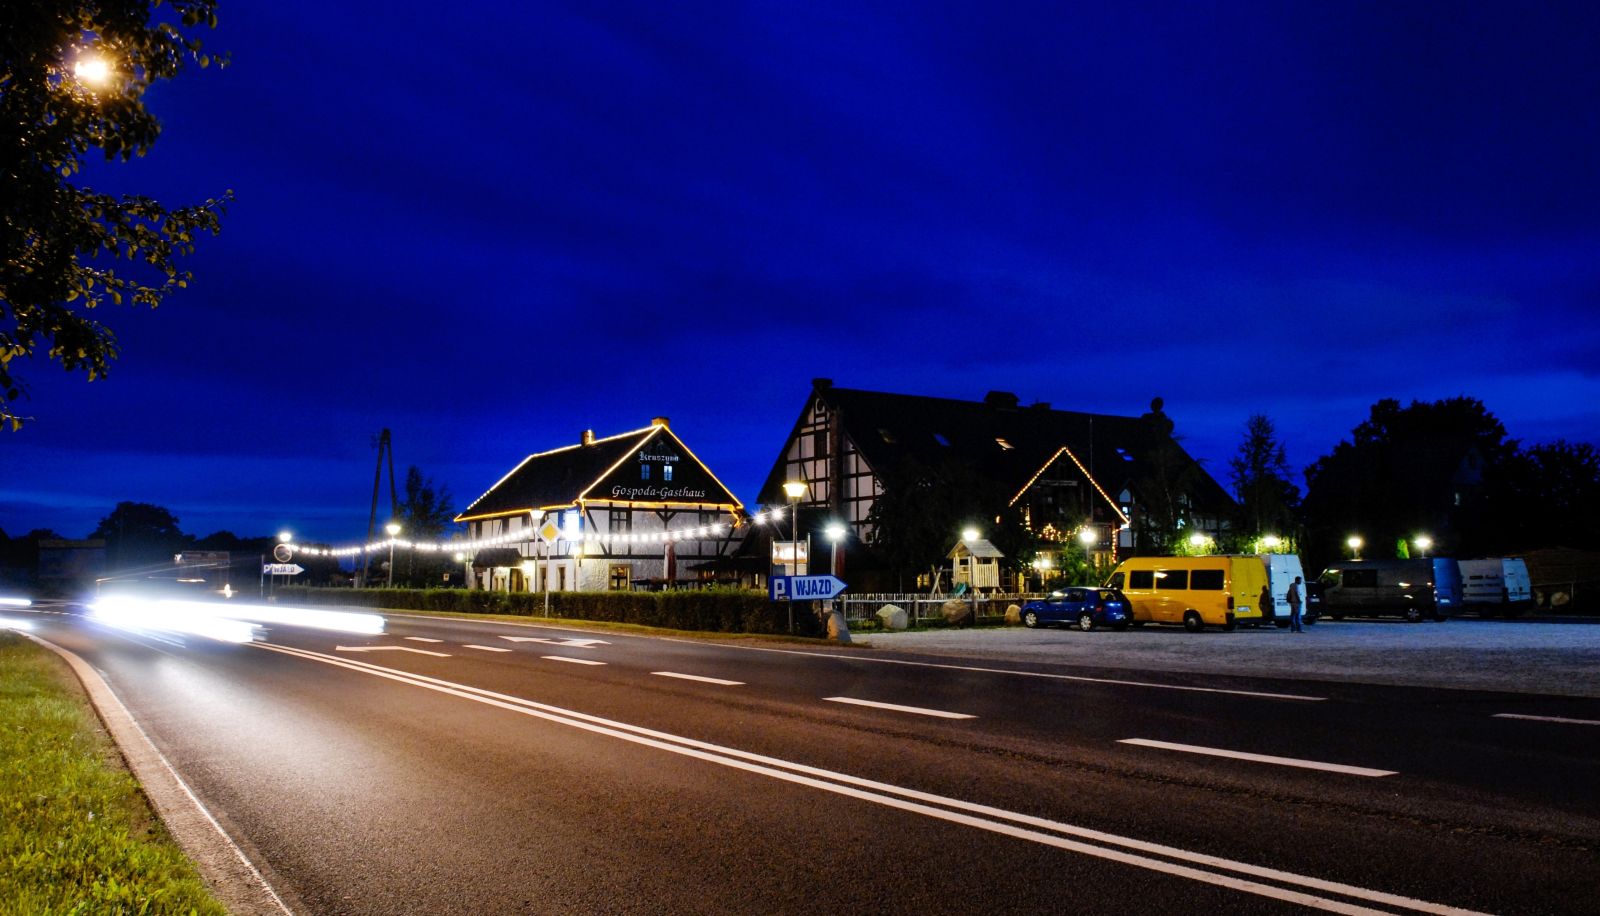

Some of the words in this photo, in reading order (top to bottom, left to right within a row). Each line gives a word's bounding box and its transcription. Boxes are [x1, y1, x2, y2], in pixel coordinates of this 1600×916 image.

[612, 485, 705, 499] Gospoda-Gasthaus
[774, 578, 786, 600] P
[795, 579, 832, 596] WJAZD
